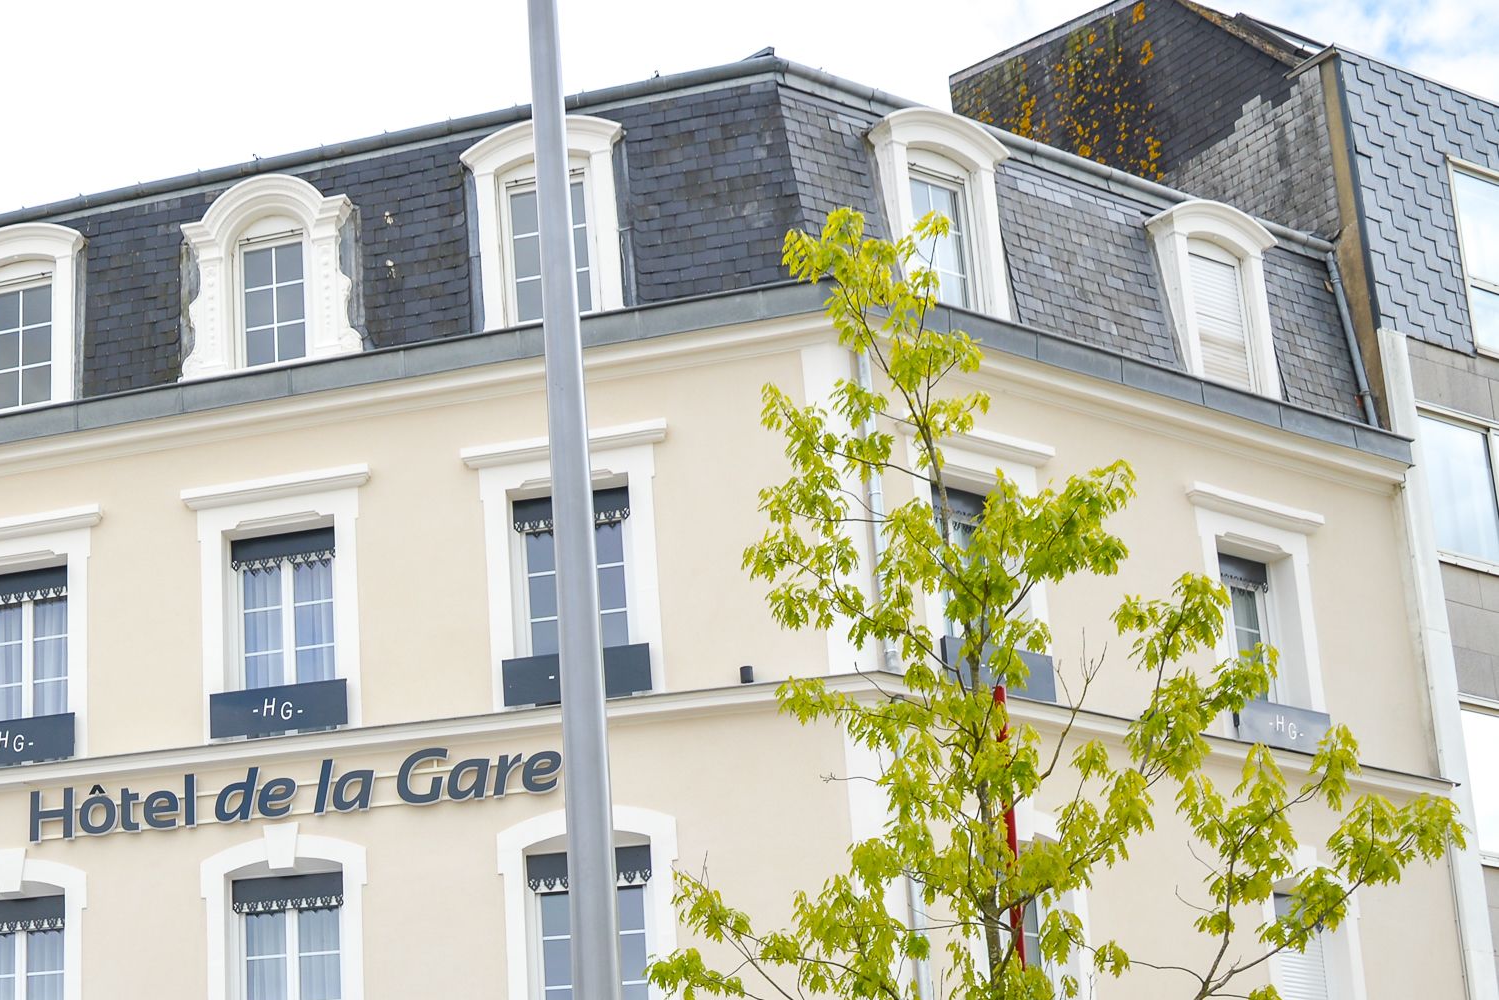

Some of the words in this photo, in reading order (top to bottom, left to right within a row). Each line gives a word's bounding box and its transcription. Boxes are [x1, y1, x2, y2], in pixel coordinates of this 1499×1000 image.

[29, 773, 198, 843] Hôtel
[214, 766, 297, 824] de
[314, 759, 376, 816] la
[396, 747, 563, 806] Gare
